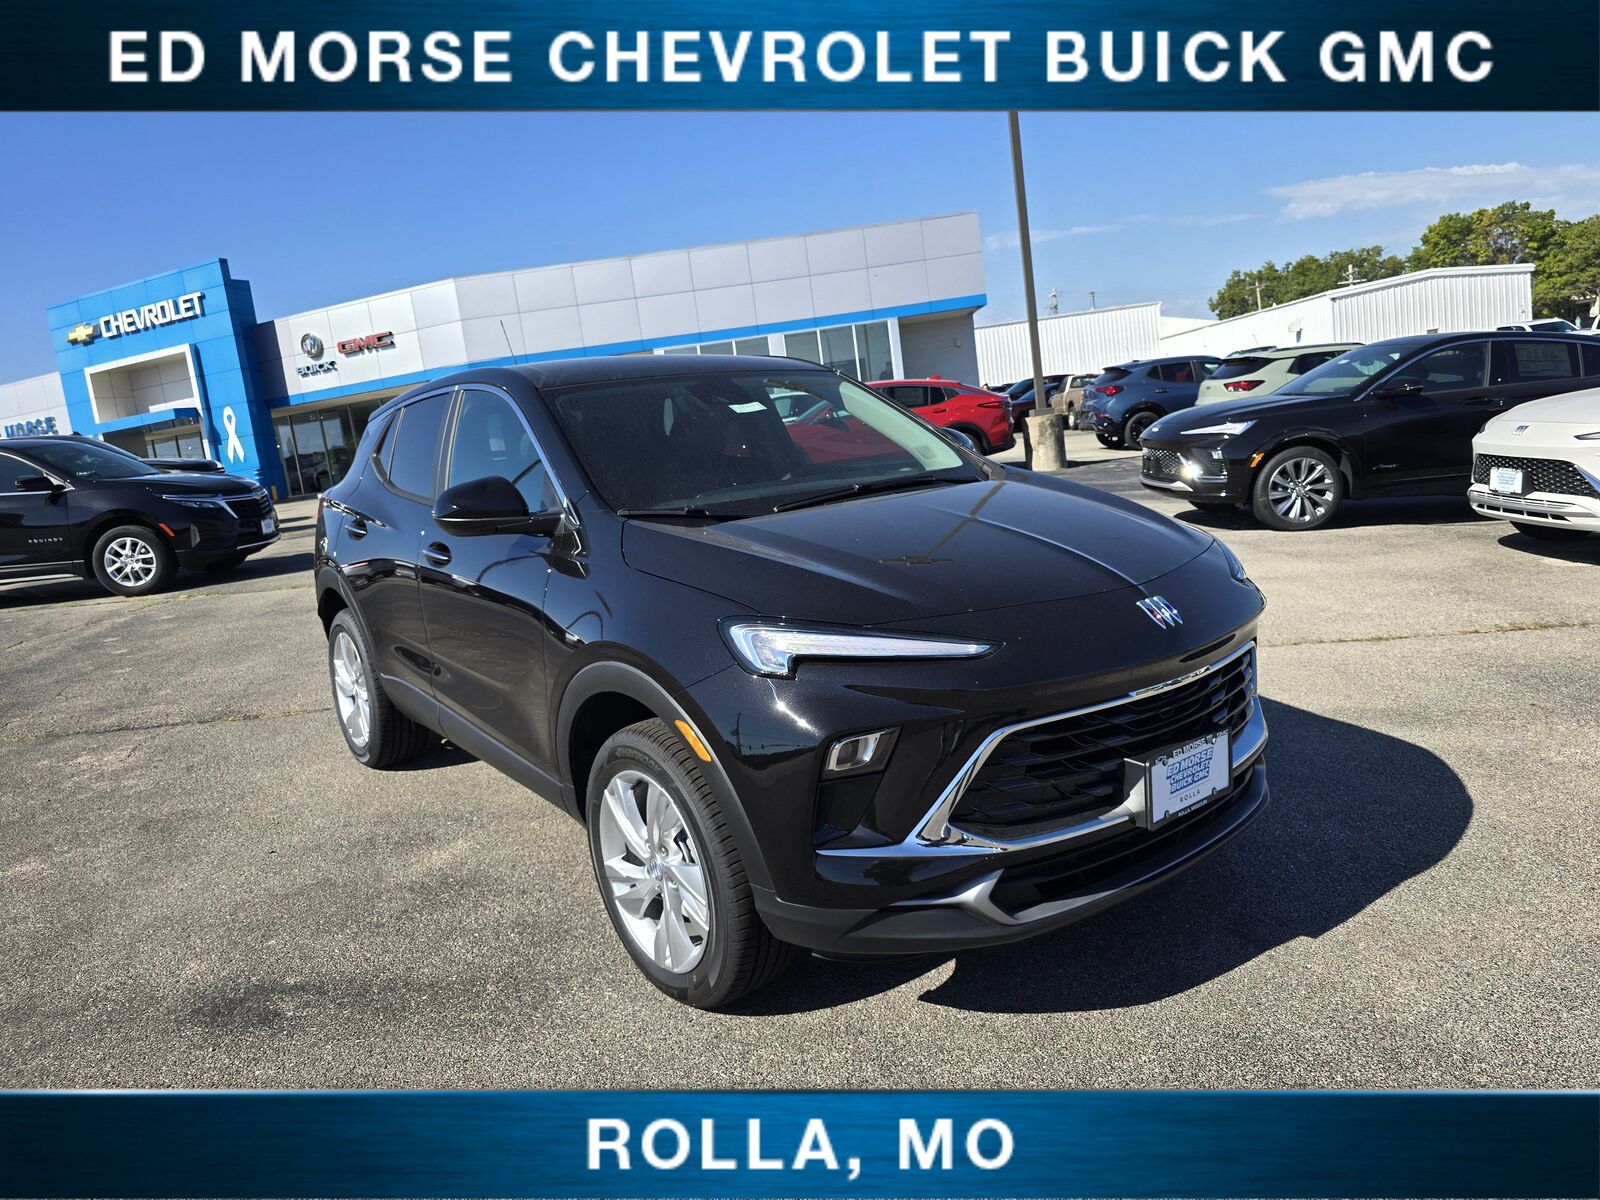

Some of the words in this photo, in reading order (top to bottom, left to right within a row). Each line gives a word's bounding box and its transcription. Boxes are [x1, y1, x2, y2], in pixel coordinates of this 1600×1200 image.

[100, 291, 203, 339] CHEVROLET
[337, 331, 395, 354] GMC
[297, 361, 337, 376] BUICK
[4, 416, 59, 438] MORSE
[1173, 748, 1182, 758] ED
[1182, 738, 1206, 753] MORSE
[1167, 762, 1180, 777] ED
[1180, 747, 1214, 772] MORSE
[1170, 761, 1210, 784] CHEVROLET
[1171, 777, 1193, 793] BUICK
[1194, 768, 1210, 781] GMC
[1180, 789, 1201, 802] ROLLA
